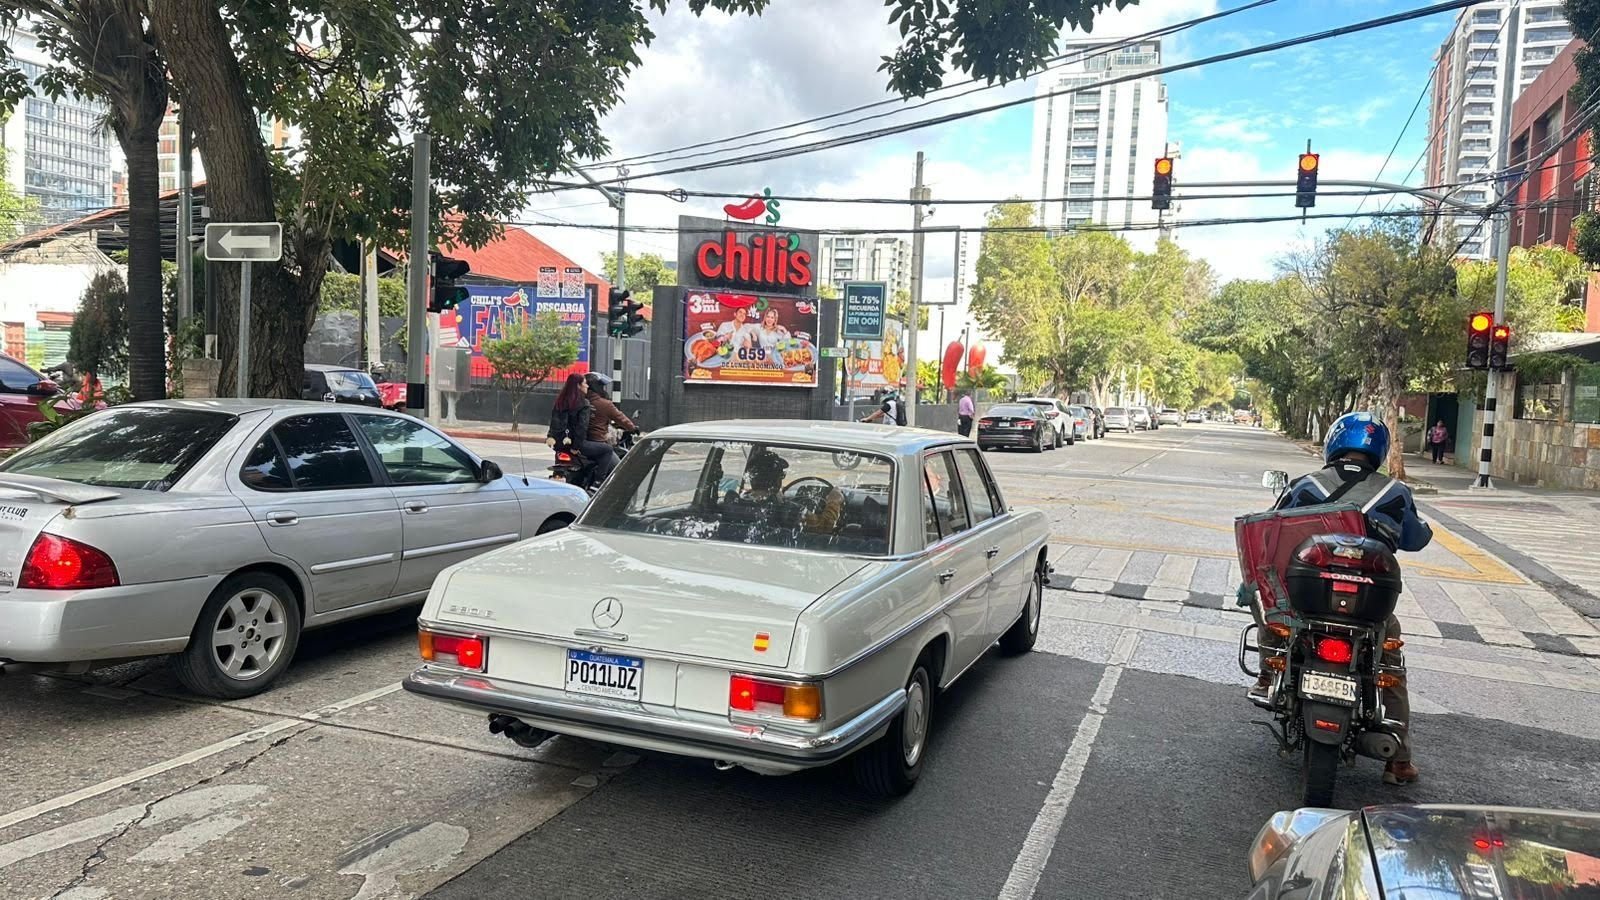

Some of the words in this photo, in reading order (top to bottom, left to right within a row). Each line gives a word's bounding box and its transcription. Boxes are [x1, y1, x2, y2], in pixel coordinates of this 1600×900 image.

[697, 229, 812, 286] chili's
[470, 295, 502, 305] CHILI'S
[849, 296, 861, 304] EL
[861, 296, 880, 305] 75%
[536, 302, 585, 313] DESCARGA
[848, 304, 880, 312] RECUERDA
[848, 317, 860, 325] EN
[860, 317, 879, 326] OOH
[738, 347, 766, 361] Q59
[7, 506, 28, 519] CLUB
[589, 654, 619, 664] GUATEMALA
[581, 684, 602, 693] CENTRO
